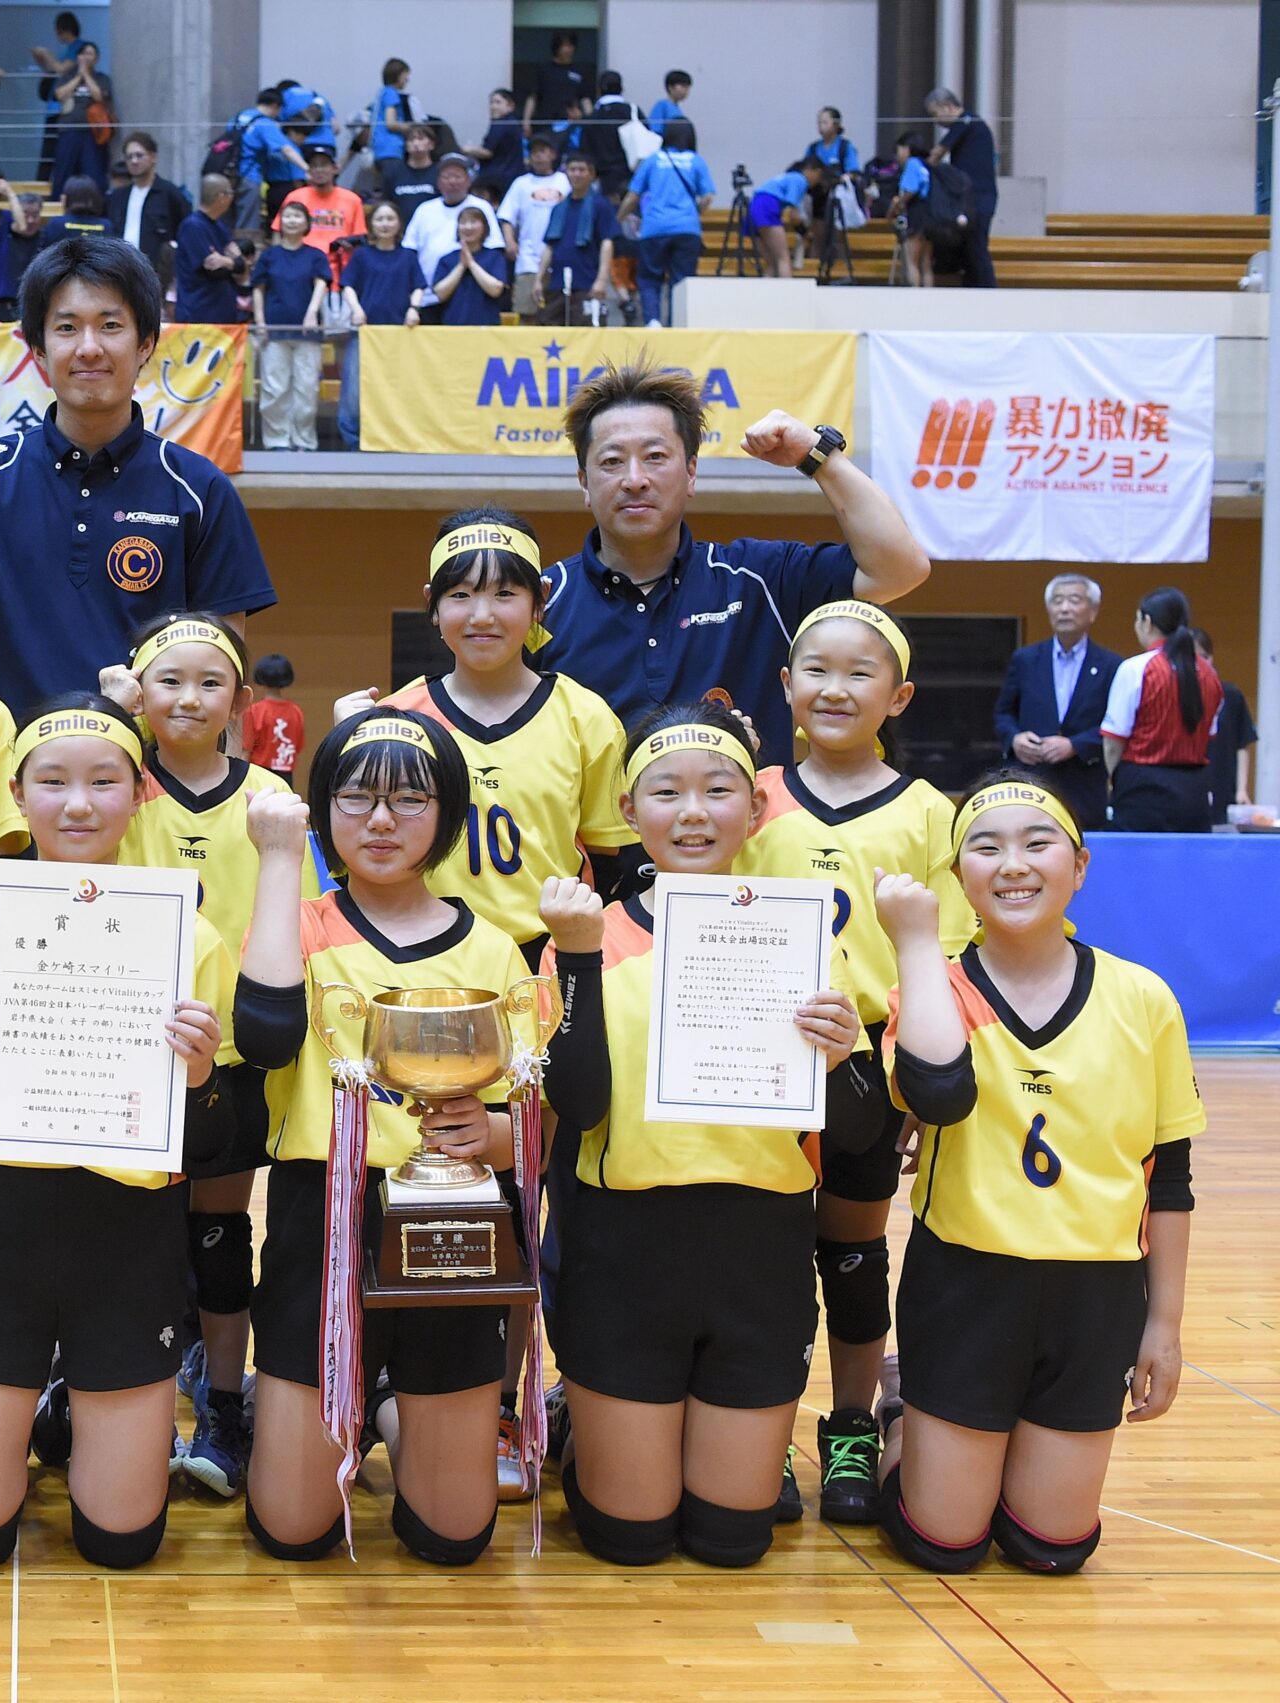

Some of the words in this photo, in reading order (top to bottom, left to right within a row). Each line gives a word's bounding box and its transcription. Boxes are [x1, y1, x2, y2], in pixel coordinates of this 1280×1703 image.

[1006, 396, 1170, 442] 暴力撤廃
[495, 424, 563, 443] Faster
[1006, 443, 1169, 479] アクション
[1006, 480, 1049, 490] ACTION
[1053, 481, 1105, 492] AGAINST
[1111, 483, 1169, 494] VIOLENCE
[447, 528, 513, 553] Smiley
[122, 549, 147, 578] C
[814, 603, 884, 624] Smiley
[156, 624, 220, 648] Smiley
[38, 714, 111, 738] Smiley
[351, 721, 426, 744] Smiley
[649, 728, 723, 754] Smiley
[970, 787, 1046, 812] Smiley
[468, 802, 522, 877] 10
[178, 847, 207, 860] TRES
[810, 859, 841, 871] TRES
[54, 914, 121, 933] 賞状
[15, 937, 48, 950] 優勝
[698, 933, 788, 946] 全国大会出場認定証
[37, 960, 140, 976] 金ケ崎スマイリー
[1020, 1081, 1053, 1095] TRES
[1022, 1112, 1062, 1189] 6
[432, 1233, 464, 1245] 優勝
